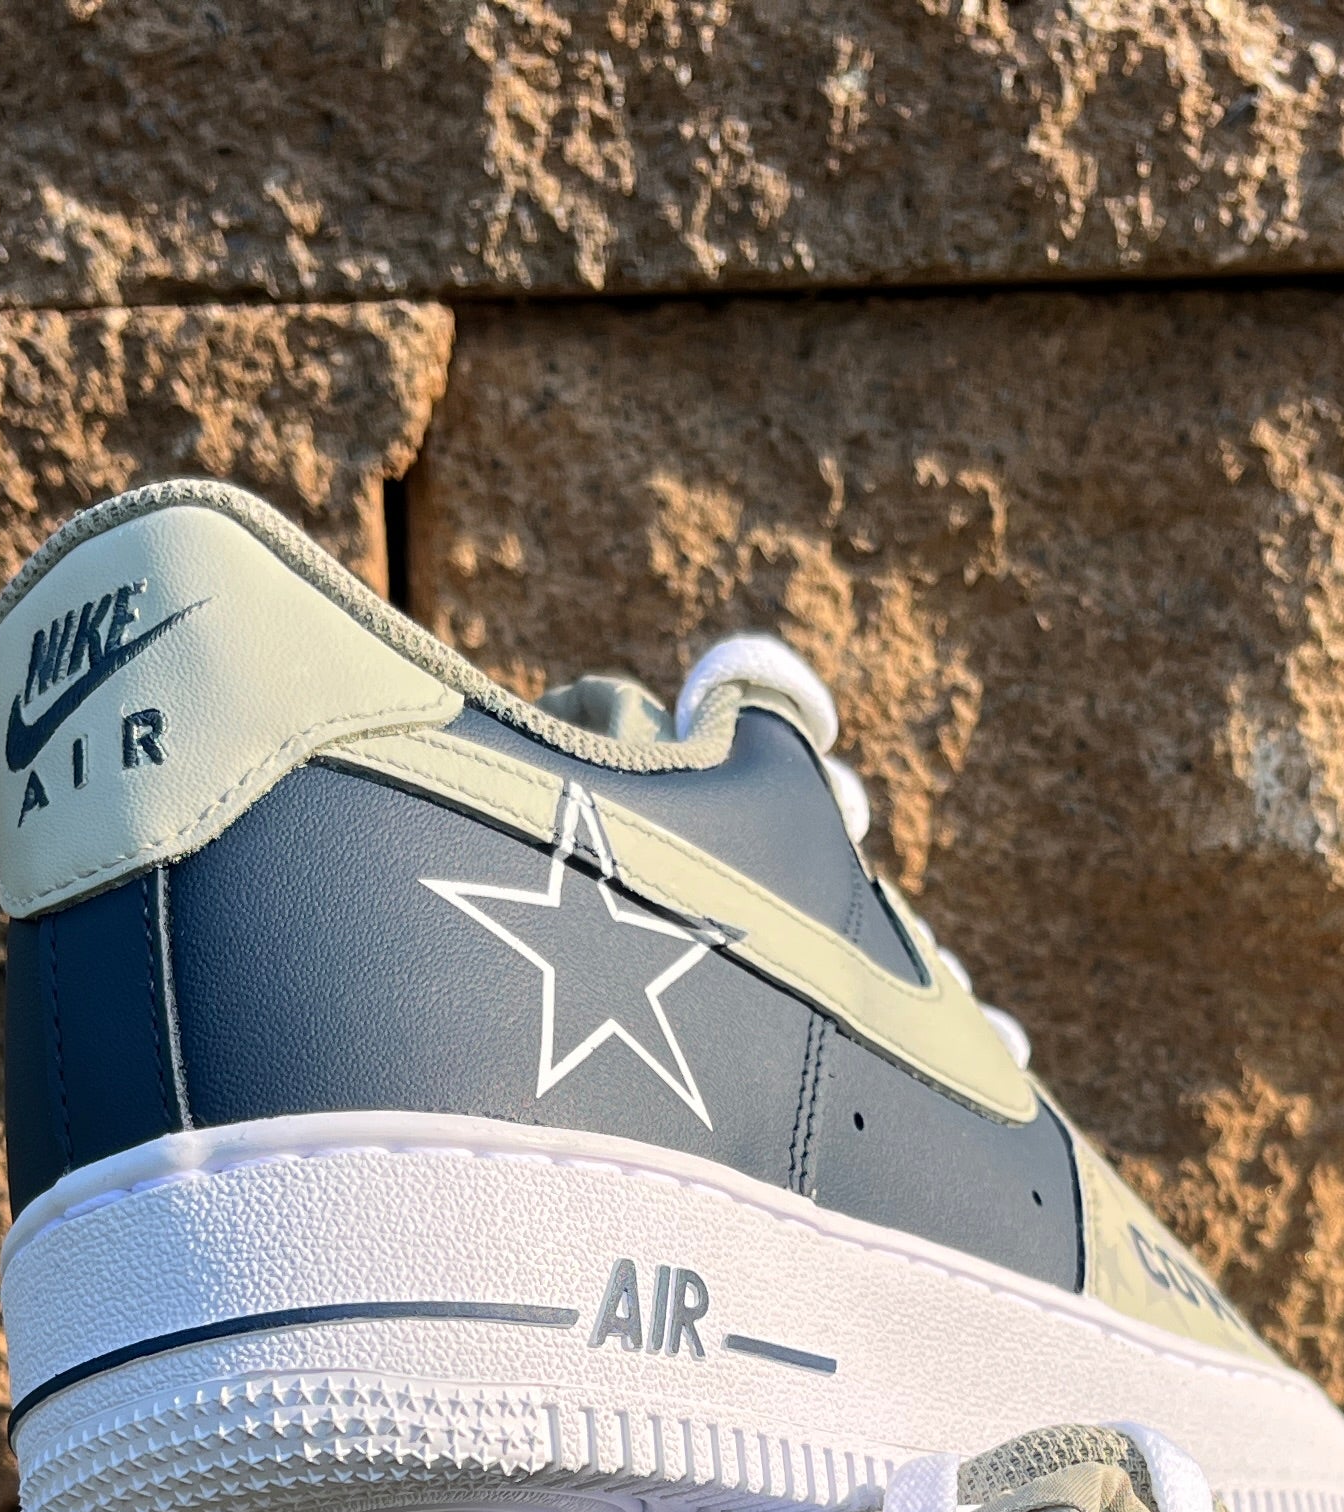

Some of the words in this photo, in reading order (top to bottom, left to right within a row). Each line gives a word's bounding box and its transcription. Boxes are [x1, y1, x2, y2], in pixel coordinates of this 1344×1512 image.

[24, 577, 149, 706] NIKE
[18, 708, 169, 828] AIR
[587, 1258, 709, 1361] AIR
